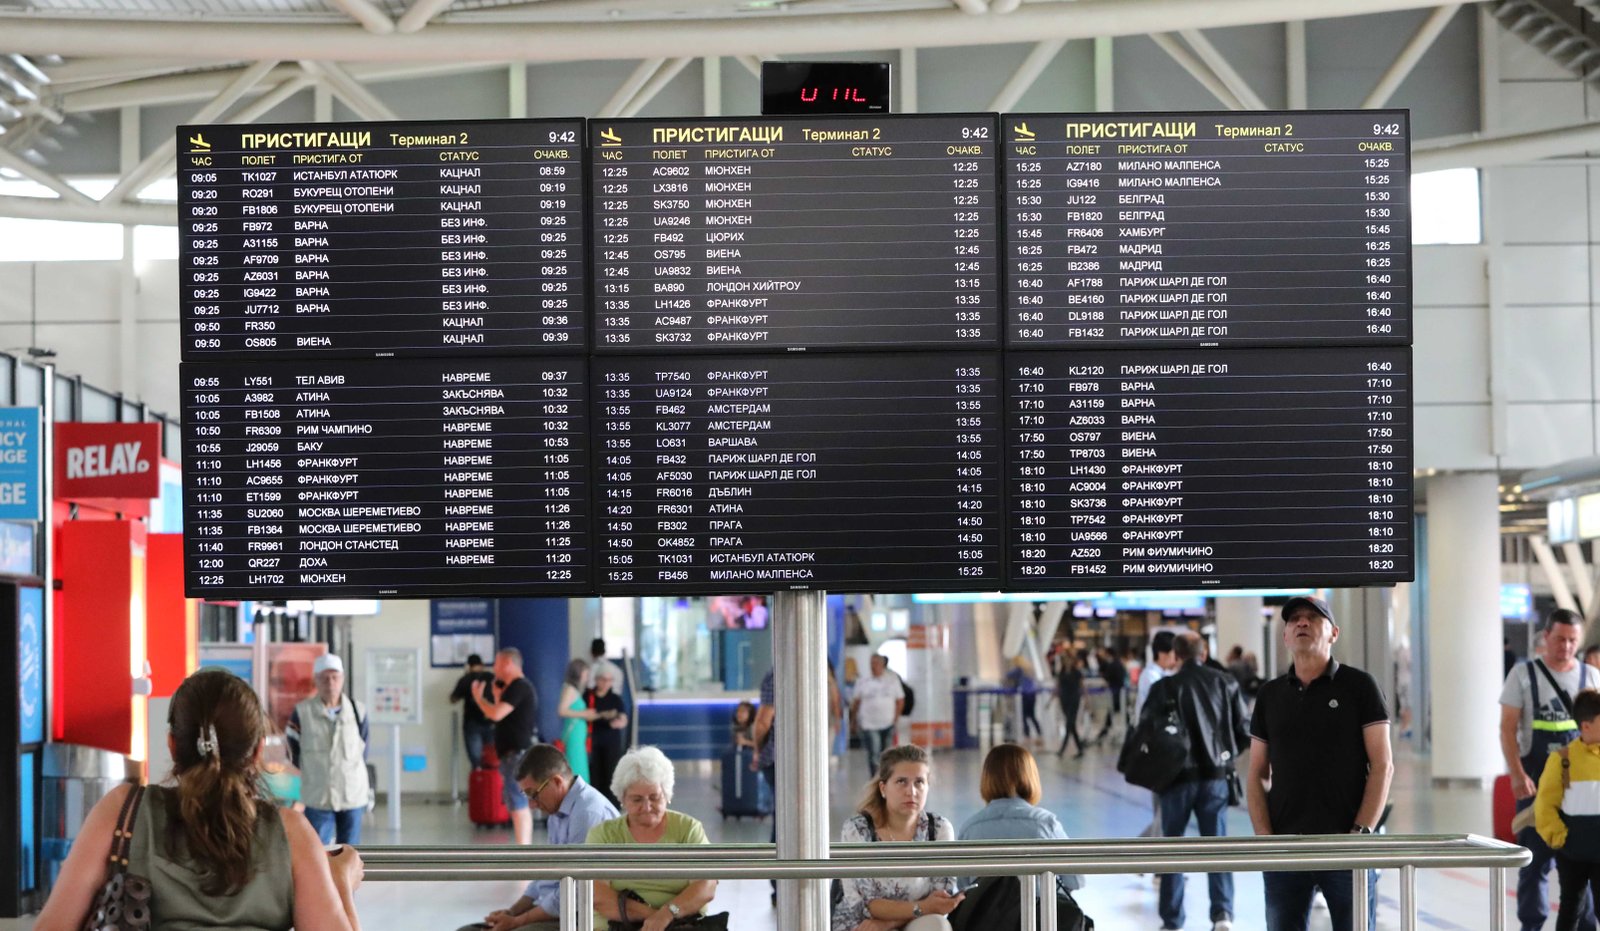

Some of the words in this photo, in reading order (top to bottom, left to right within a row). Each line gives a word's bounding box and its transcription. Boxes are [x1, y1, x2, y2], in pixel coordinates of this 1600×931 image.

[653, 126, 783, 144] ПРИСТИГАЩИ
[802, 128, 869, 142] Терминал
[872, 128, 881, 140] 2
[962, 127, 988, 138] 9:42
[1067, 122, 1196, 140] ПРИСТИГАЩИ
[1215, 124, 1281, 138] Терминал
[1285, 124, 1292, 136] 2
[1373, 124, 1399, 135] 9:42
[242, 132, 370, 149] ПРИСТИГАЩИ
[389, 132, 456, 147] Терминал
[460, 133, 468, 144] 2
[549, 131, 575, 142] 9:42
[601, 150, 623, 161] ЧАС
[652, 149, 688, 160] ПОЛЕТ
[704, 148, 760, 159] ПРИСТИГА
[760, 148, 776, 159] ОТ
[851, 146, 892, 157] СТАТУС
[946, 145, 983, 156] ОЧАКВ.
[1015, 145, 1037, 156] ЧАС
[1066, 144, 1101, 155] ПОЛЕТ
[1118, 145, 1171, 154] ПРИСТИГА
[1174, 144, 1188, 154] ОТ
[1264, 142, 1305, 153] СТАТУС
[1358, 141, 1395, 152] ОЧАКВ.
[191, 156, 212, 167] ЧАС
[241, 155, 276, 166] ПОЛЕТ
[293, 153, 347, 164] ПРИСТИГА
[348, 153, 363, 164] ОТ
[439, 150, 480, 162] СТАТУС
[533, 149, 570, 160] ОЧАКВ.
[191, 172, 218, 183] 09:05
[241, 171, 277, 182] TK1027
[293, 170, 348, 181] ИСТАНБУЛ
[349, 169, 398, 180] АТАТЮРК
[439, 167, 481, 180] КАЦНАЛ
[539, 166, 566, 176] 08:59
[602, 167, 628, 177] 12:25
[652, 166, 690, 177] AC9602
[704, 165, 752, 176] МЮНХЕН
[952, 161, 979, 172] 12:25
[1016, 178, 1042, 189] 15:25
[1066, 178, 1100, 189] IG9416
[1118, 177, 1163, 188] МИЛАНО
[1164, 176, 1222, 187] МАЛПЕНСА
[1364, 174, 1391, 185] 15:25
[1016, 195, 1042, 206] 15:30
[1066, 194, 1097, 205] JU122
[1118, 194, 1165, 206] БЕЛГРАД
[1364, 191, 1391, 202] 15:30
[192, 222, 219, 233] 09:25
[242, 221, 273, 232] FB972
[294, 220, 329, 231] ВАРНА
[440, 217, 461, 228] БЕЗ
[463, 218, 488, 228] ИНФ.
[540, 215, 567, 226] 09:25
[1016, 228, 1043, 239] 15:45
[1067, 227, 1104, 238] FR6406
[1118, 227, 1167, 238] ХАМБУРГ
[1365, 224, 1391, 235] 15:45
[603, 233, 629, 244] 12:25
[653, 232, 684, 243] FB492
[705, 231, 745, 244] ЦЮРИХ
[953, 228, 980, 238] 12:25
[1017, 245, 1043, 255] 16:25
[1067, 244, 1098, 255] FB472
[1119, 244, 1163, 255] МАДРИД
[1365, 241, 1391, 251] 16:25
[604, 283, 630, 294] 13:15
[653, 282, 685, 293] BA890
[706, 281, 751, 293] ЛОНДОН
[752, 279, 801, 292] ХИЙТРОУ
[954, 278, 981, 288] 13:15
[194, 322, 221, 332] 09:50
[244, 321, 276, 331] FR350
[442, 317, 484, 329] КАЦНАЛ
[541, 315, 569, 326] 09:36
[604, 333, 631, 343] 13:35
[655, 332, 692, 343] SK3732
[706, 331, 769, 342] ФРАНКФУРТ
[955, 328, 981, 338] 13:35
[605, 372, 630, 382] 13:35
[654, 371, 691, 382] TP7540
[706, 370, 769, 381] ФРАНКФУРТ
[955, 367, 981, 377] 13:35
[1018, 366, 1044, 376] 16:40
[1068, 365, 1105, 376] KL2120
[1120, 365, 1159, 375] ПАРИЖ
[1159, 364, 1190, 375] ШАРЛ
[1190, 364, 1206, 376] ДЕ
[1207, 363, 1228, 374] ГОЛ
[1366, 361, 1392, 372] 16:40
[193, 377, 220, 387] 09:55
[244, 376, 272, 386] LY551
[295, 375, 315, 385] ТЕЛ
[316, 375, 345, 385] АВИВ
[442, 372, 491, 383] НАВРЕМЕ
[541, 371, 568, 381] 09:37
[1018, 383, 1045, 393] 17:10
[1069, 382, 1100, 392] FB978
[1120, 381, 1156, 392] ВАРНА
[1366, 378, 1393, 388] 17:10
[194, 393, 220, 404] 10:05
[244, 392, 274, 403] A3982
[295, 392, 331, 402] АТИНА
[442, 388, 505, 400] ЗАКЪСНЯВА
[542, 387, 568, 398] 10:32
[605, 421, 631, 431] 13:55
[656, 421, 691, 431] KL3077
[707, 420, 771, 432] АМСТЕРДАМ
[956, 417, 982, 427] 13:55
[1019, 432, 1045, 443] 17:50
[1069, 432, 1102, 442] OS797
[1121, 431, 1157, 442] ВИЕНА
[1367, 427, 1393, 438] 17:50
[606, 455, 632, 465] 14:05
[656, 454, 687, 465] FB432
[708, 453, 747, 464] ПАРИЖ
[747, 453, 778, 463] ШАРЛ
[779, 453, 794, 464] ДЕ
[795, 452, 817, 463] ГОЛ
[956, 450, 982, 460] 14:05
[606, 488, 632, 498] 14:15
[656, 487, 693, 498] FR6016
[708, 487, 752, 498] ДЪБЛИН
[957, 483, 982, 493] 14:15
[198, 542, 224, 552] 11:40
[247, 541, 283, 551] FR9961
[299, 540, 343, 552] ЛОНДОН
[344, 539, 399, 551] СТАНСТЕД
[445, 538, 495, 548] НАВРЕМЕ
[545, 536, 571, 547] 11:25
[1020, 548, 1046, 559] 18:20
[1070, 548, 1101, 558] AZ520
[1122, 547, 1145, 557] РИМ
[1146, 546, 1213, 557] ФИУМИЧИНО
[1368, 543, 1394, 553] 18:20
[199, 575, 225, 585] 12:25
[248, 574, 285, 584] LH1702
[300, 573, 346, 584] МЮНХЕН
[546, 569, 572, 580] 12:25
